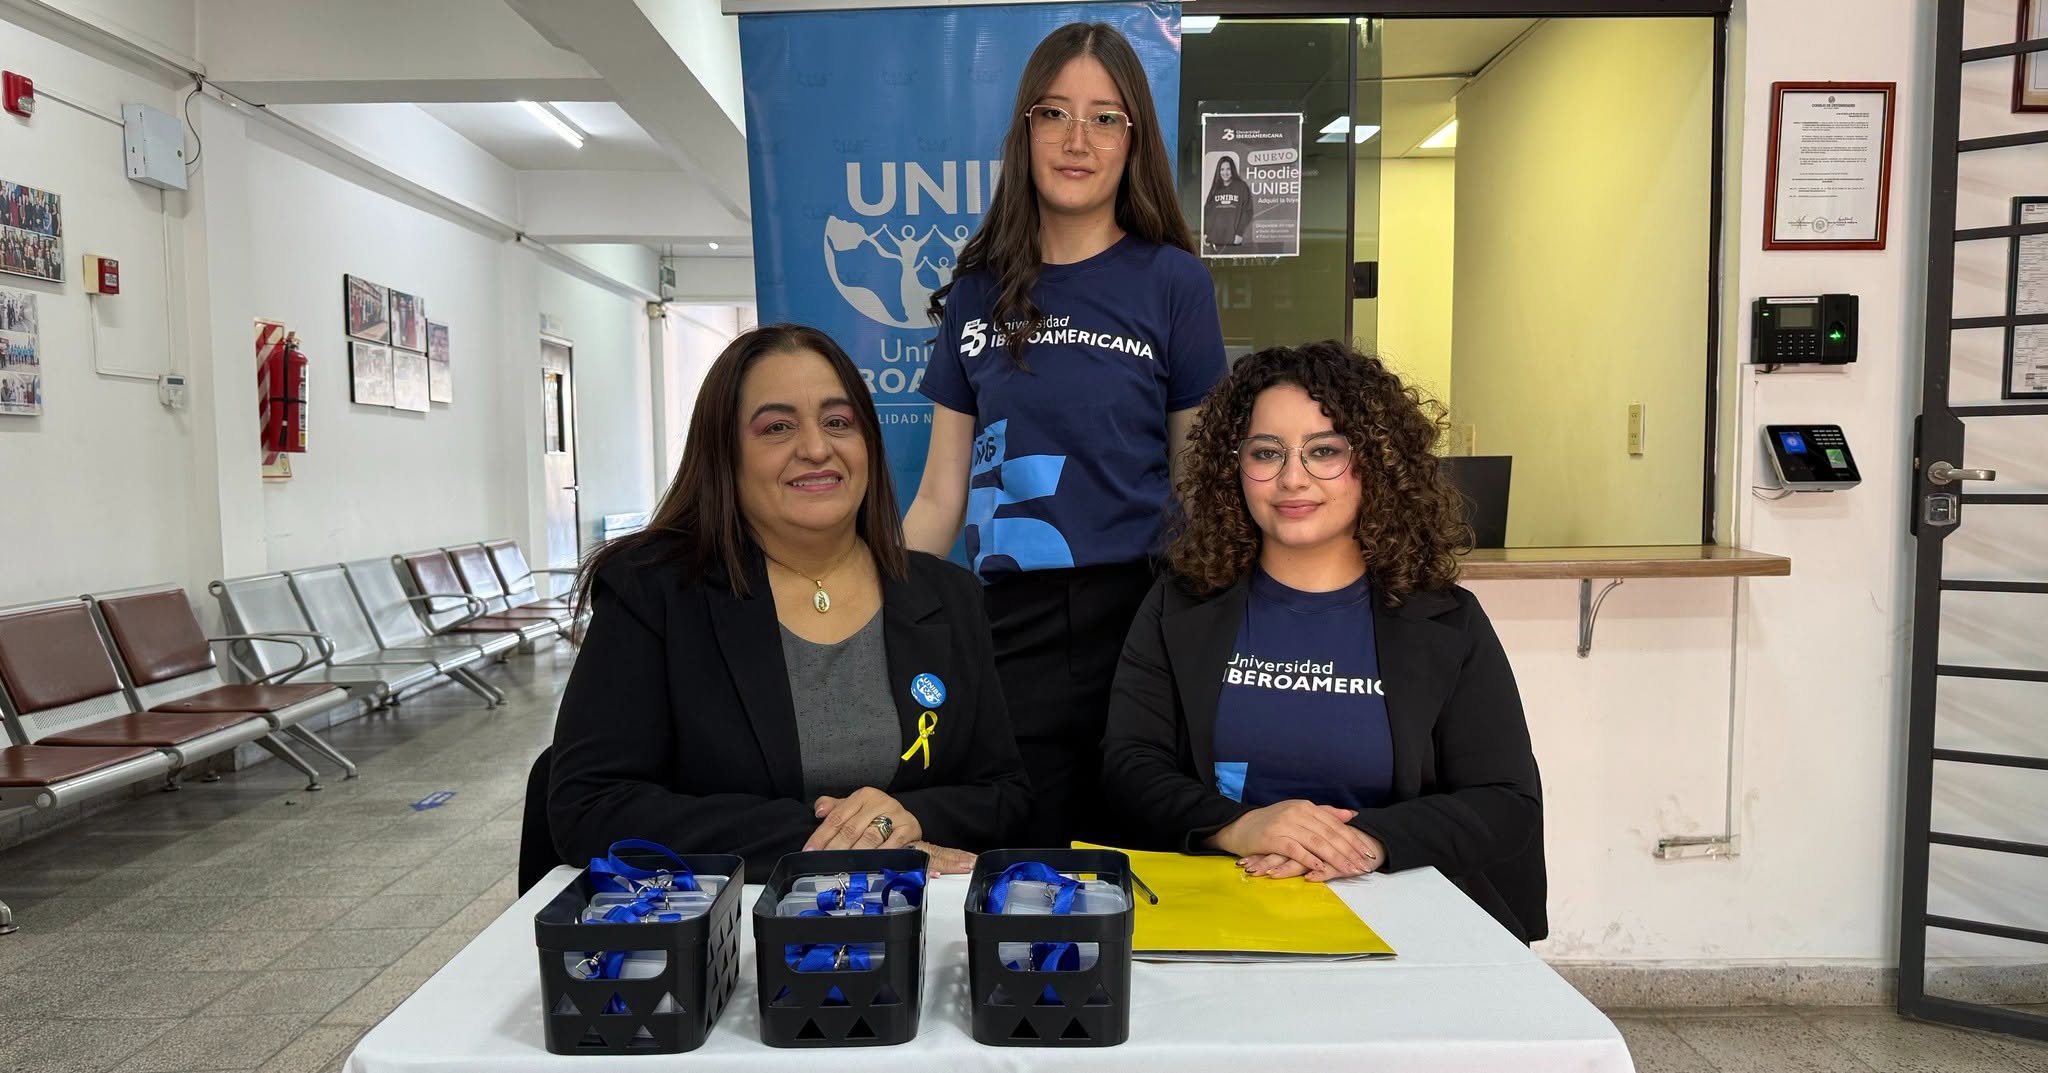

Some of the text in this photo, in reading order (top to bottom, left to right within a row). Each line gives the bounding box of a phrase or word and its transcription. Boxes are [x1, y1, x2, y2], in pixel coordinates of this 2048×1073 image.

[1254, 152, 1293, 162] NUEVO
[1246, 166, 1299, 180] Hoodie
[1251, 181, 1299, 195] UNIBE
[1214, 194, 1239, 202] UNIBE
[923, 677, 942, 699] UNIBE
